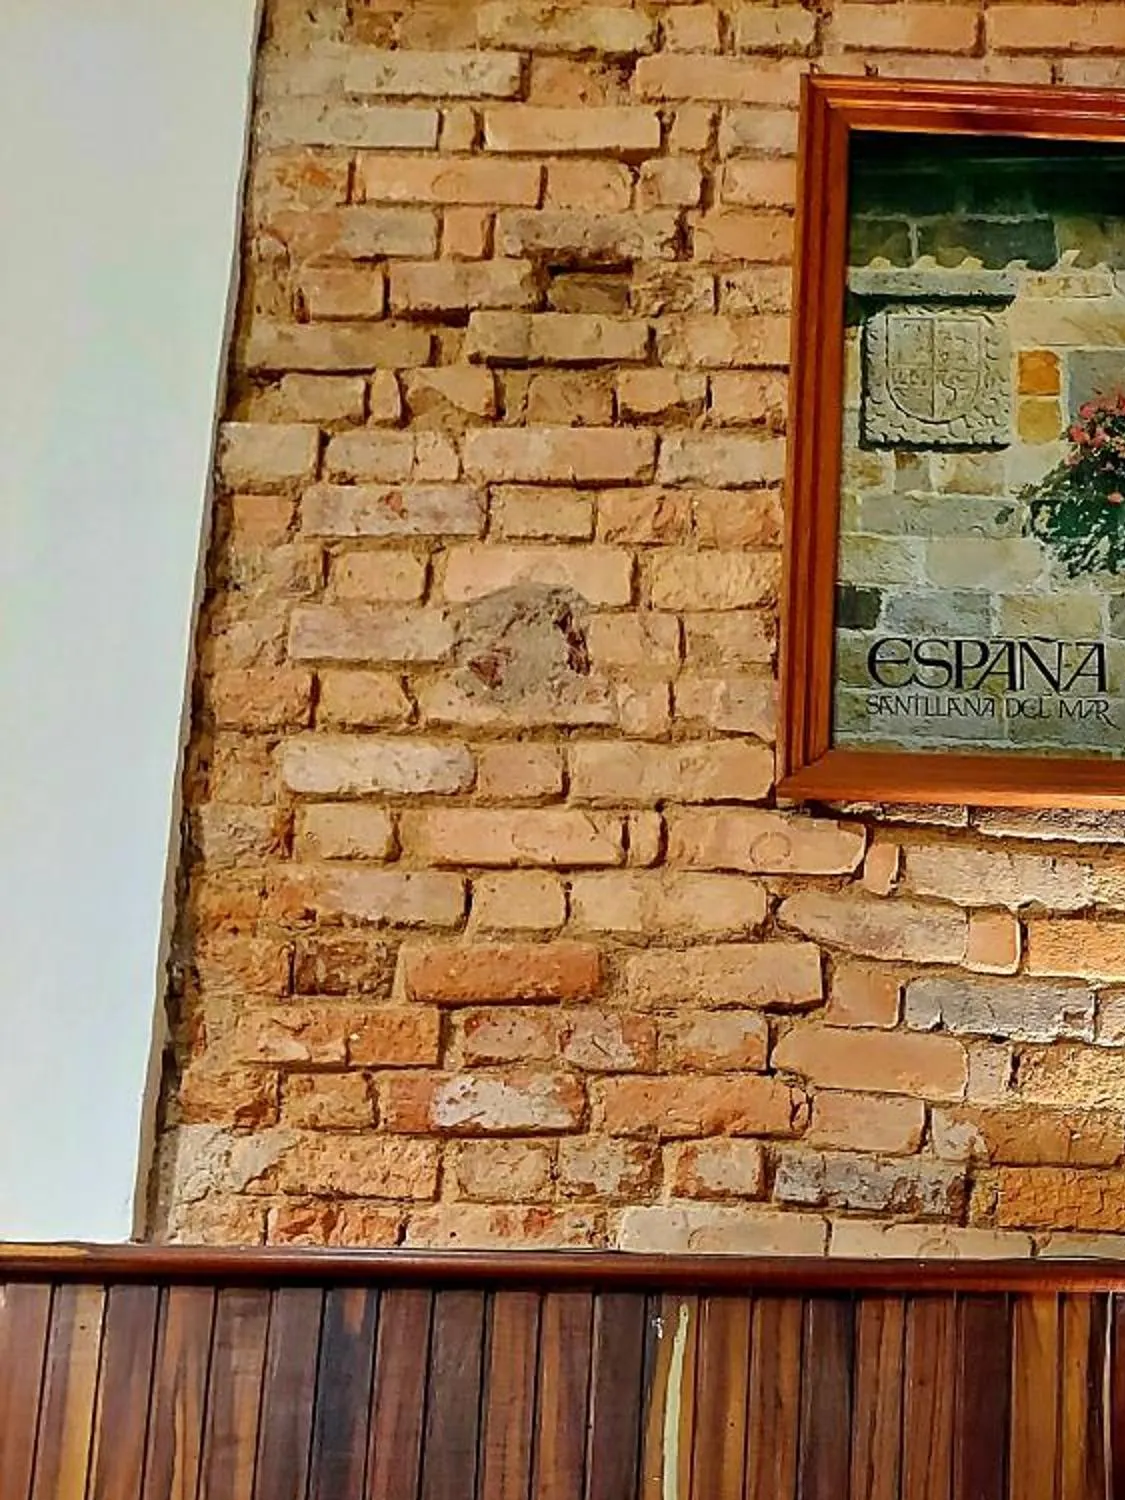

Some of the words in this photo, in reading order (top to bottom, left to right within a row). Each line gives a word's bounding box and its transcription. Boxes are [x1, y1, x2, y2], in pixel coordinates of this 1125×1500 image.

[868, 636, 1107, 693] ESPAÑA
[1006, 698, 1050, 719] DEL
[1060, 699, 1121, 730] MAR
